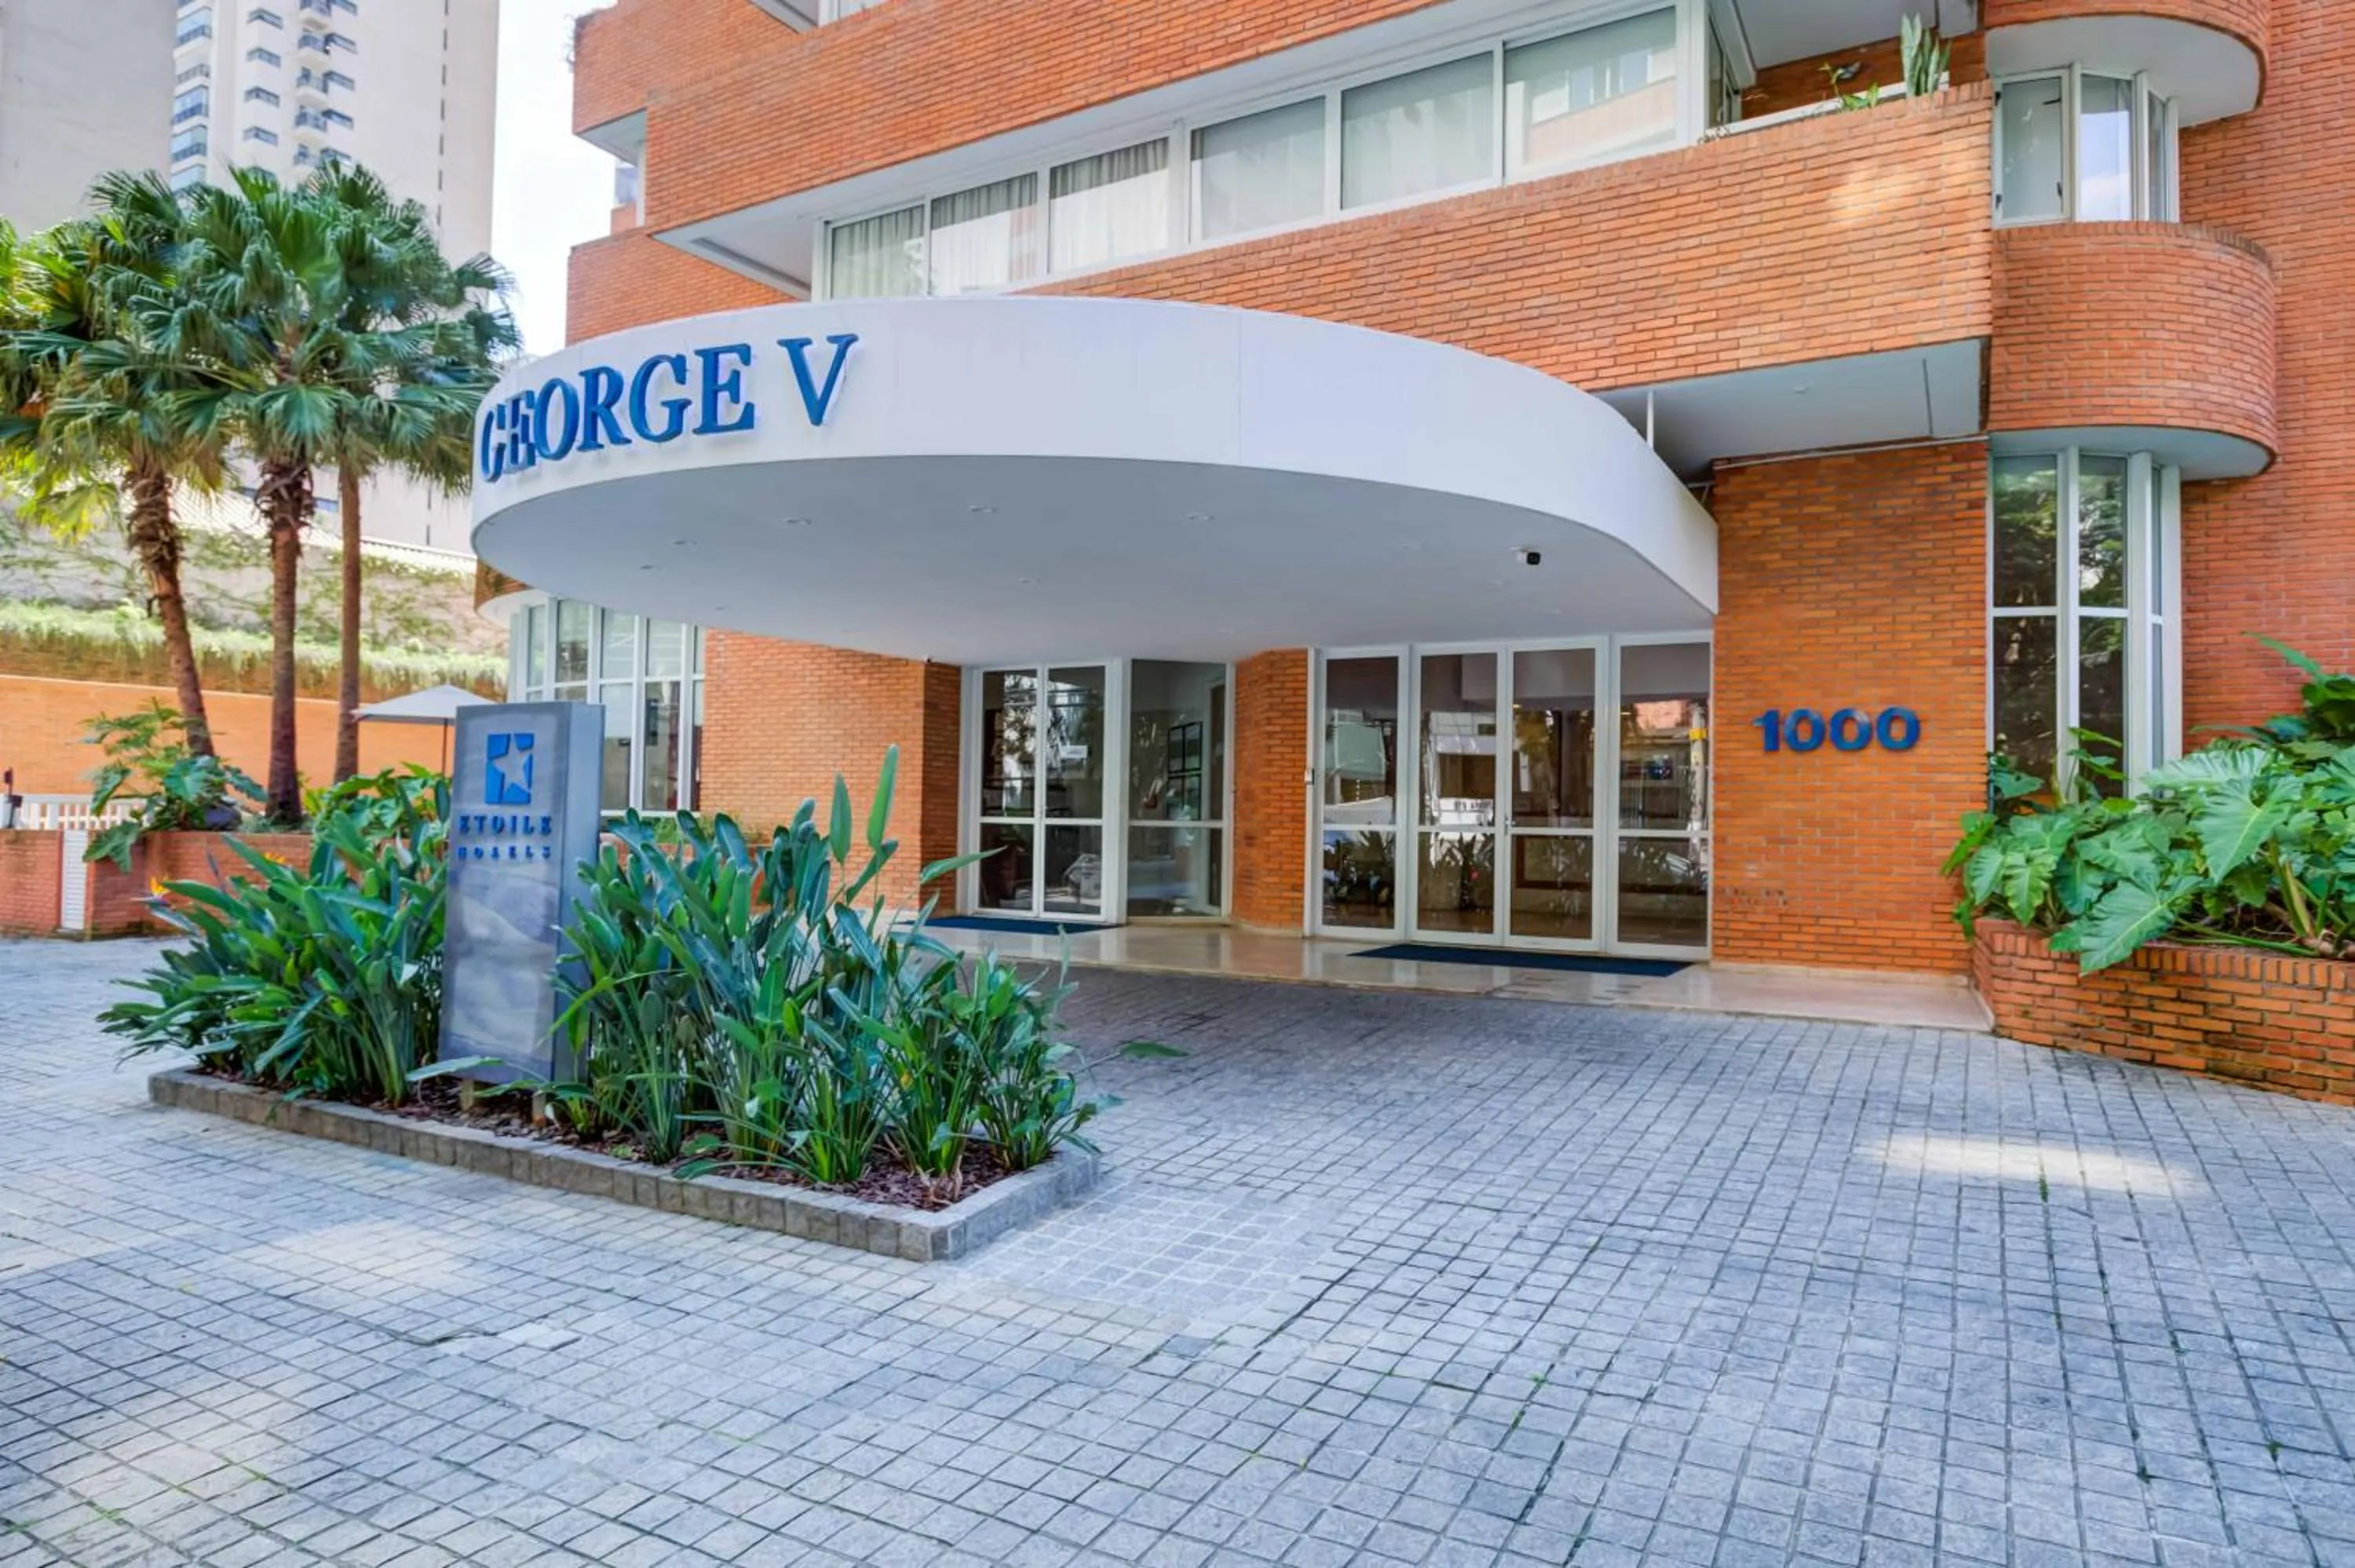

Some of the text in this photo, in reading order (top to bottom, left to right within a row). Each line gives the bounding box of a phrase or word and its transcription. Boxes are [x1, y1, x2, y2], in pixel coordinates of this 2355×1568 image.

[480, 333, 860, 483] GEORGE V
[1753, 707, 1920, 752] 1000
[459, 815, 552, 835] ETOILE
